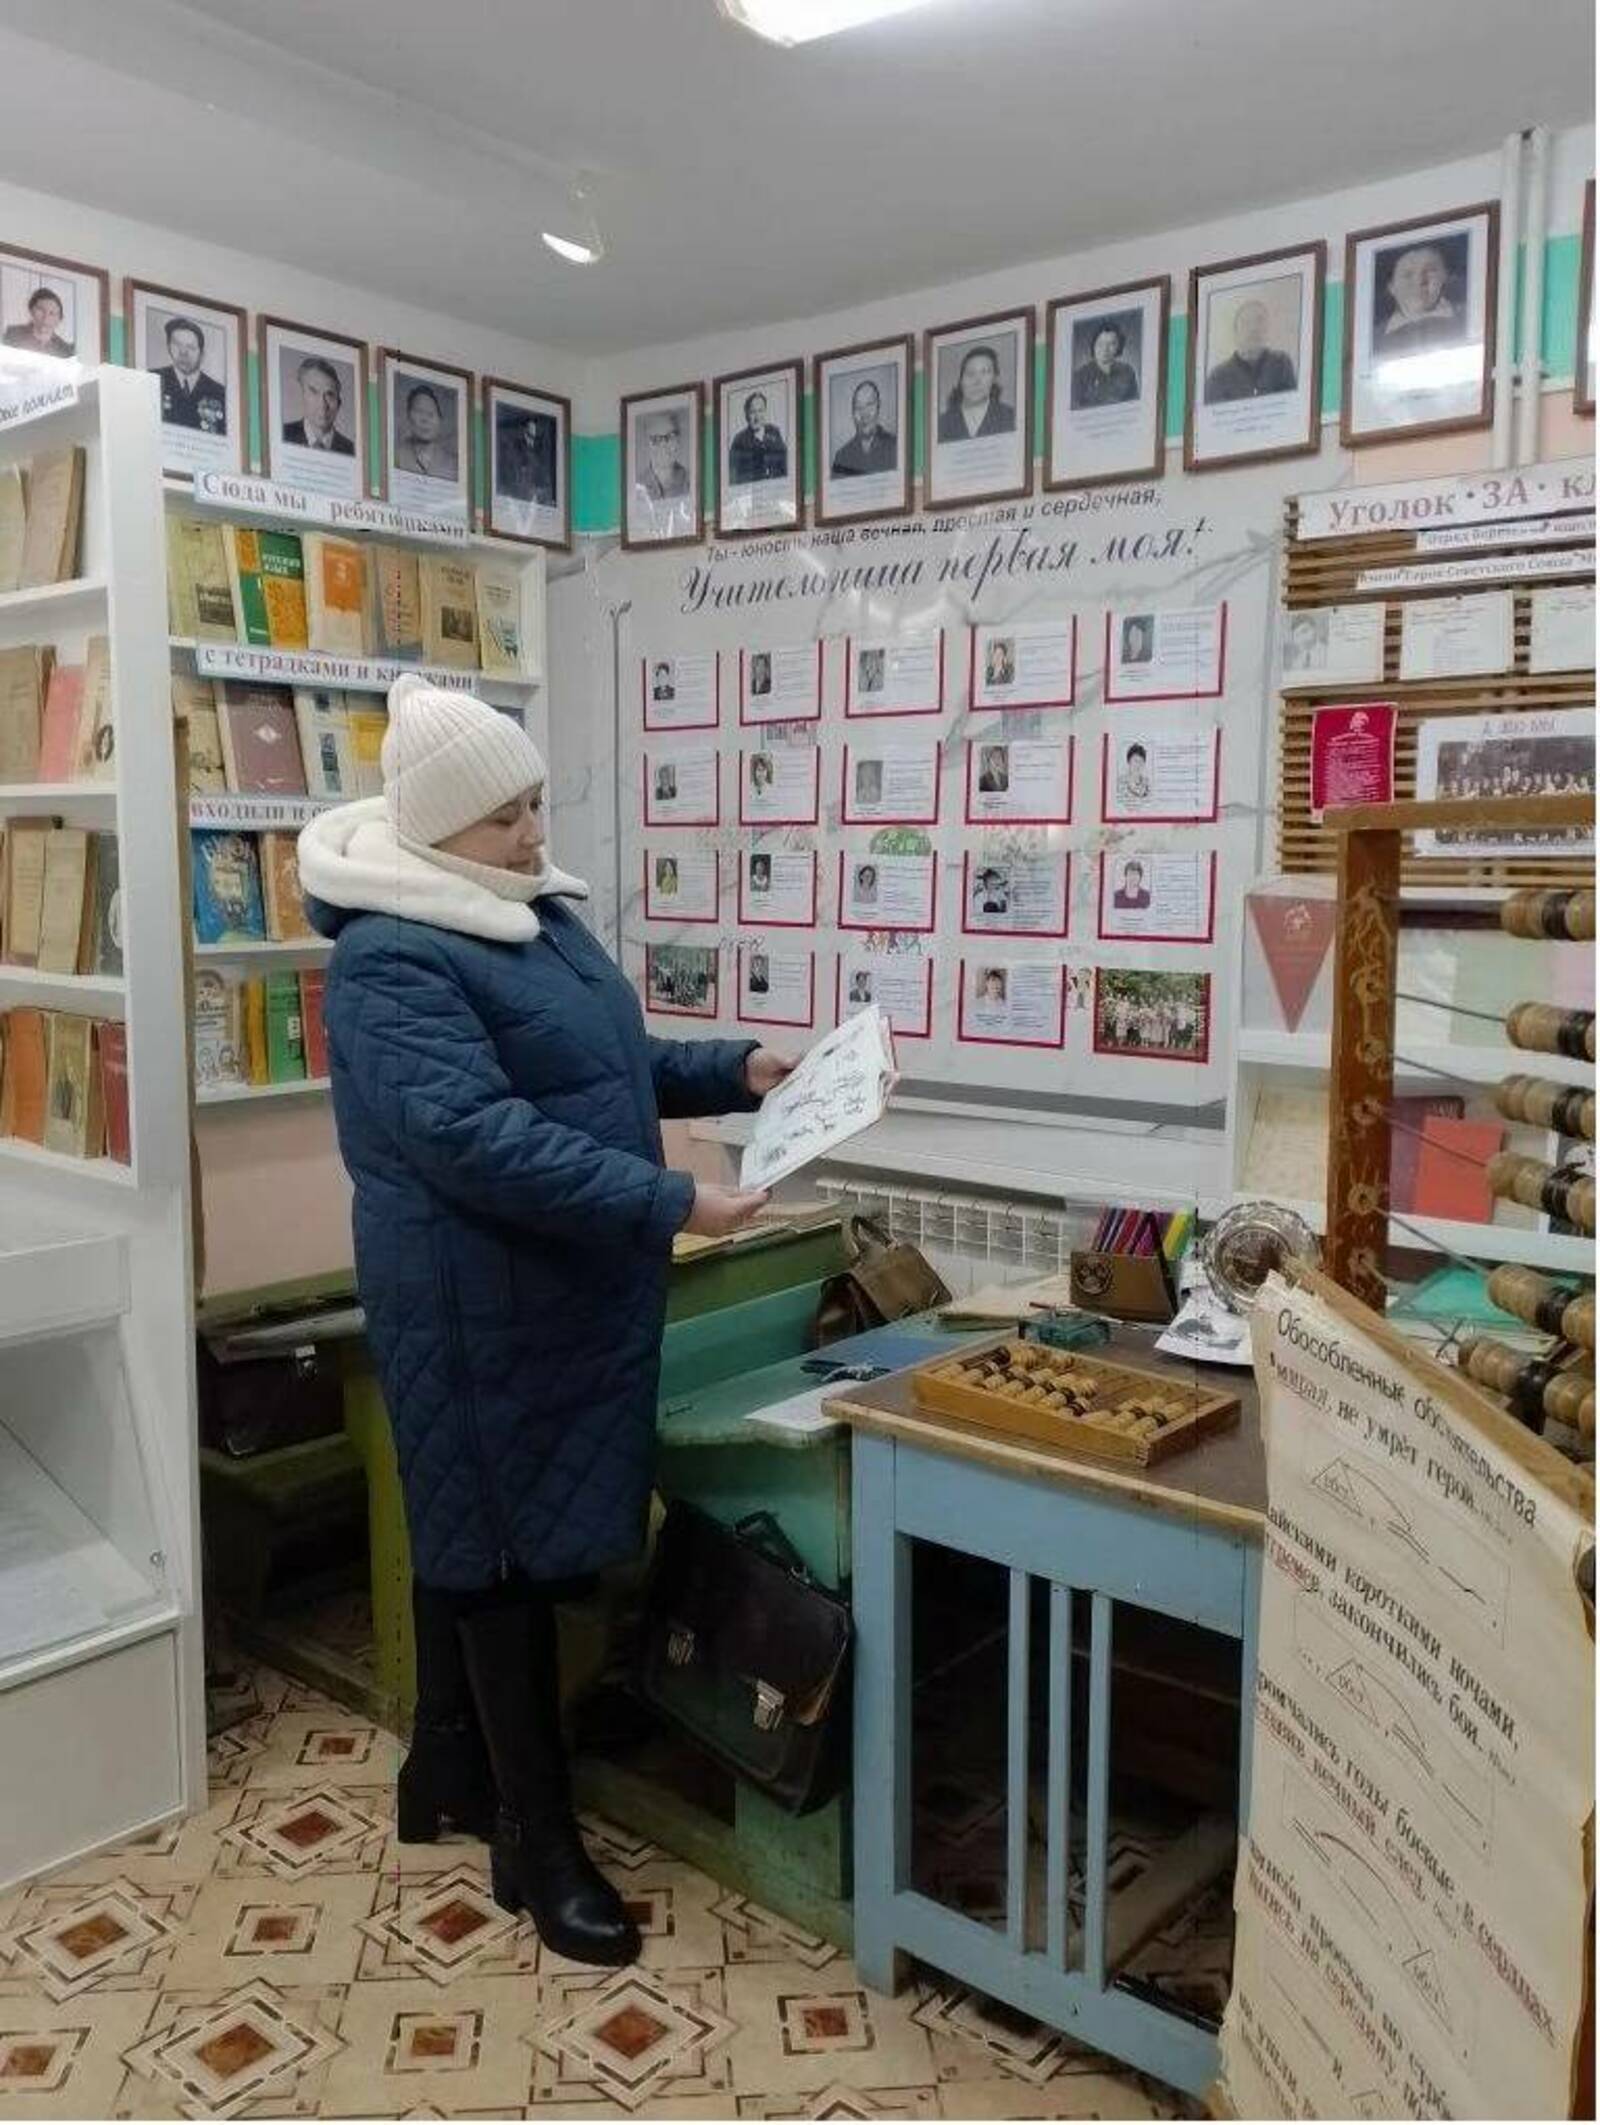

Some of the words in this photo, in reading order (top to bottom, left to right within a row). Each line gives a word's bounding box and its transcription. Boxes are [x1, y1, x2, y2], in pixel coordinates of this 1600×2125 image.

[204, 472, 265, 503] Сюда
[274, 491, 306, 511] мы
[1329, 493, 1456, 529] Уголок
[1482, 476, 1529, 510] ЗА
[811, 527, 856, 550] наша
[1022, 507, 1035, 521] и
[938, 527, 1078, 602] первая
[205, 650, 215, 664] с
[223, 651, 349, 680] тетрадками
[355, 666, 368, 680] и
[1345, 1566, 1442, 1661] короткими
